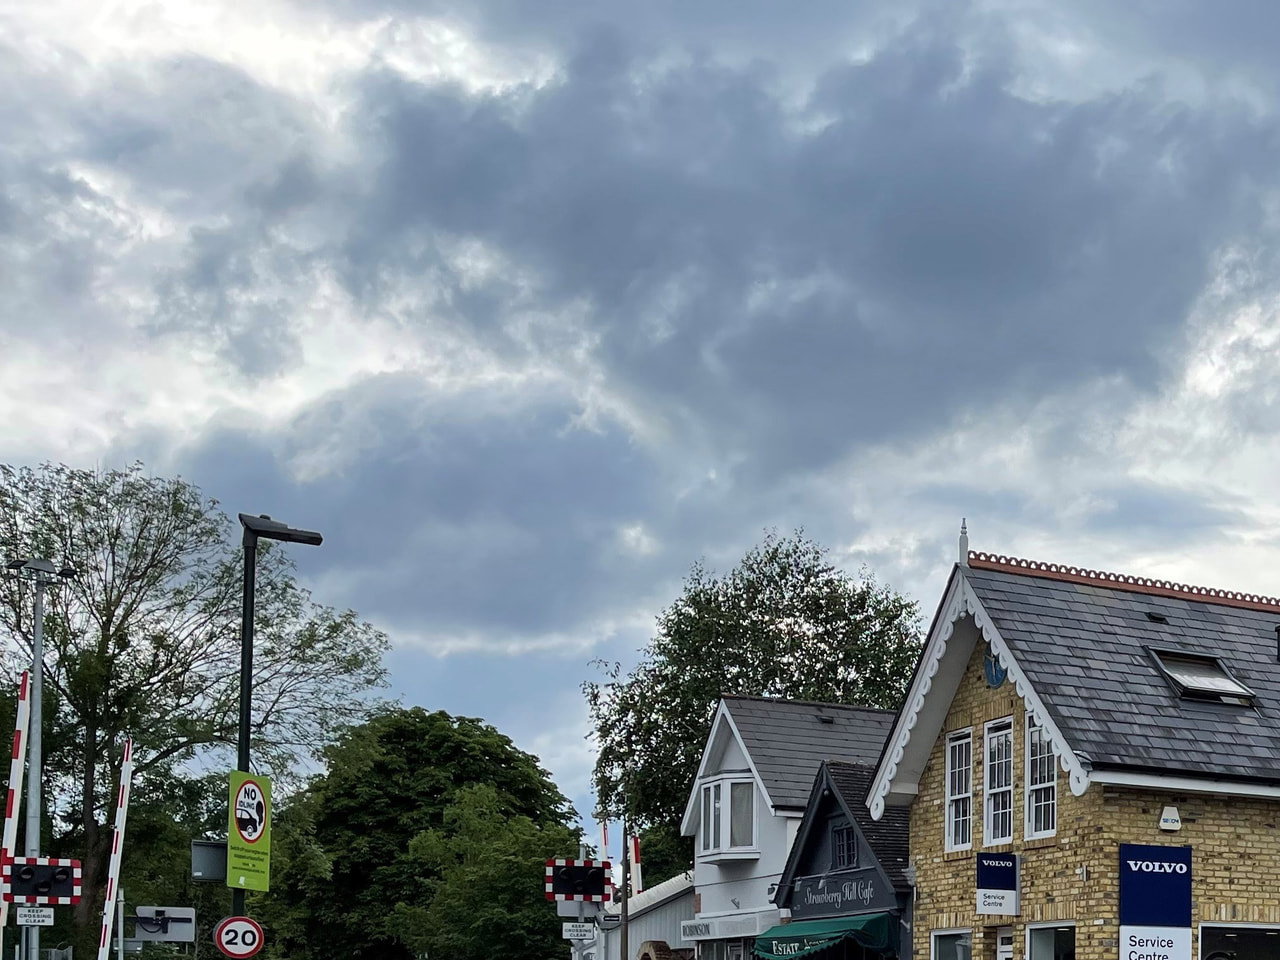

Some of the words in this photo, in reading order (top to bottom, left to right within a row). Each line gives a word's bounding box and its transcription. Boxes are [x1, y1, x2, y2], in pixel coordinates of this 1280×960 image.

[243, 787, 257, 801] NO
[982, 859, 1013, 867] VOLVO
[1127, 860, 1188, 874] VOLVO
[804, 887, 841, 908] Strawberry
[842, 881, 857, 901] Hill
[224, 929, 257, 946] 20
[1128, 935, 1174, 948] Service
